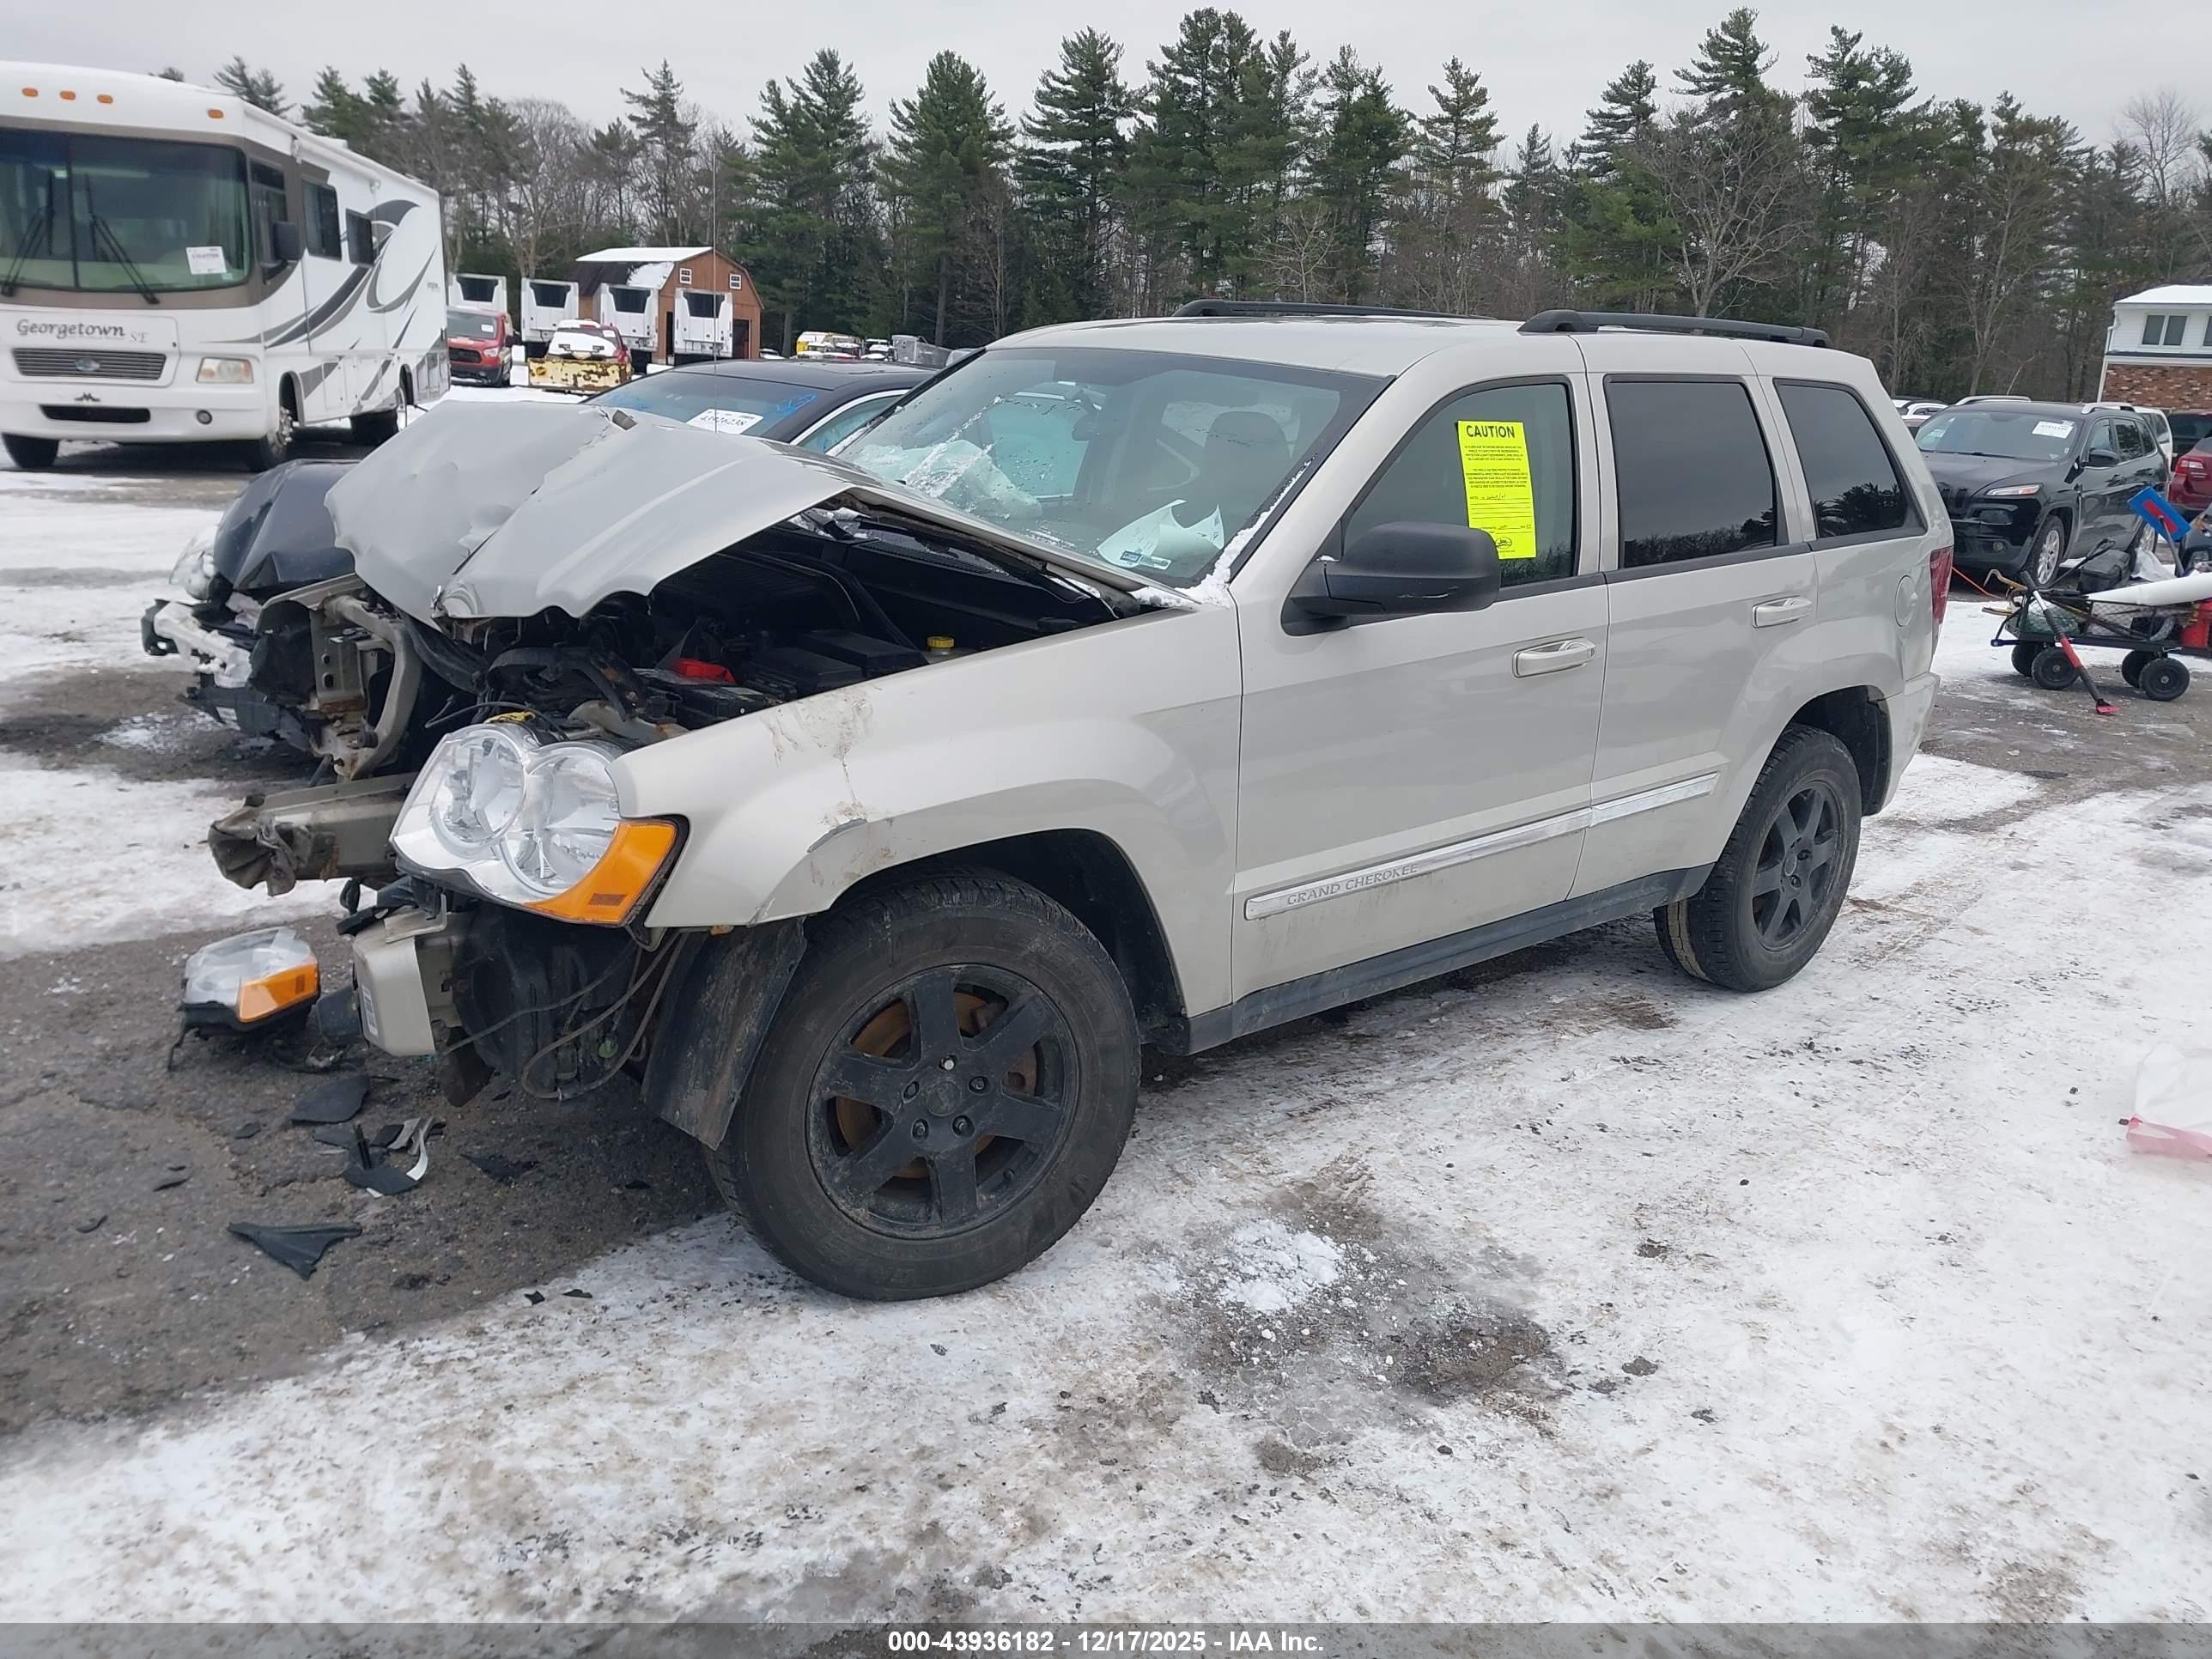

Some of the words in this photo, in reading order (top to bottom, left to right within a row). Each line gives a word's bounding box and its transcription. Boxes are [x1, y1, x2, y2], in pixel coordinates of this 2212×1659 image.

[16, 319, 125, 339] Georgetown
[1466, 425, 1516, 439] CAUTION
[1287, 884, 1341, 905] GRAND
[1345, 863, 1419, 890] CHEROKEE
